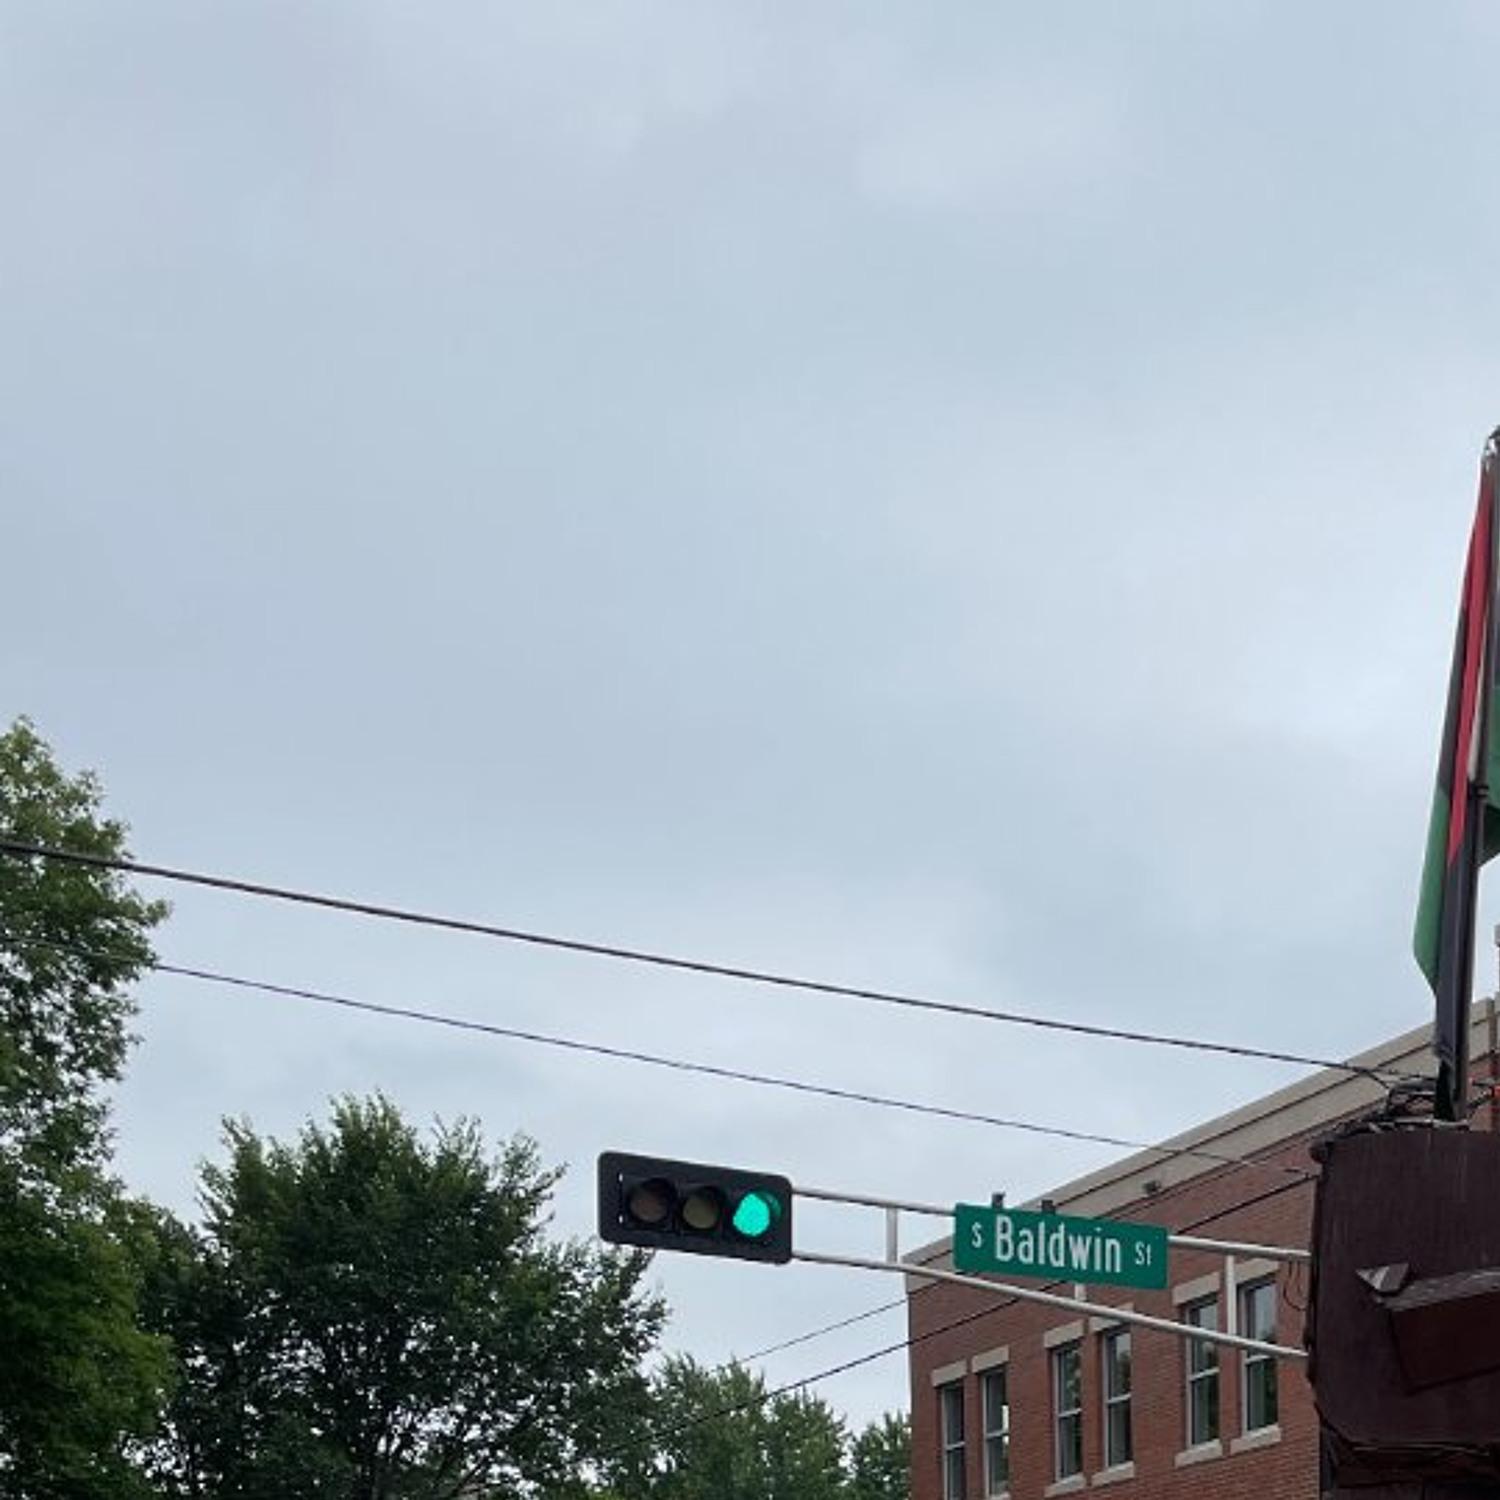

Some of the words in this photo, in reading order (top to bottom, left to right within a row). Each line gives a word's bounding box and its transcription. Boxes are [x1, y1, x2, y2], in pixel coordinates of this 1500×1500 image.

[971, 1222, 983, 1248] S
[995, 1216, 1122, 1273] Baldwin
[1135, 1241, 1152, 1267] St
